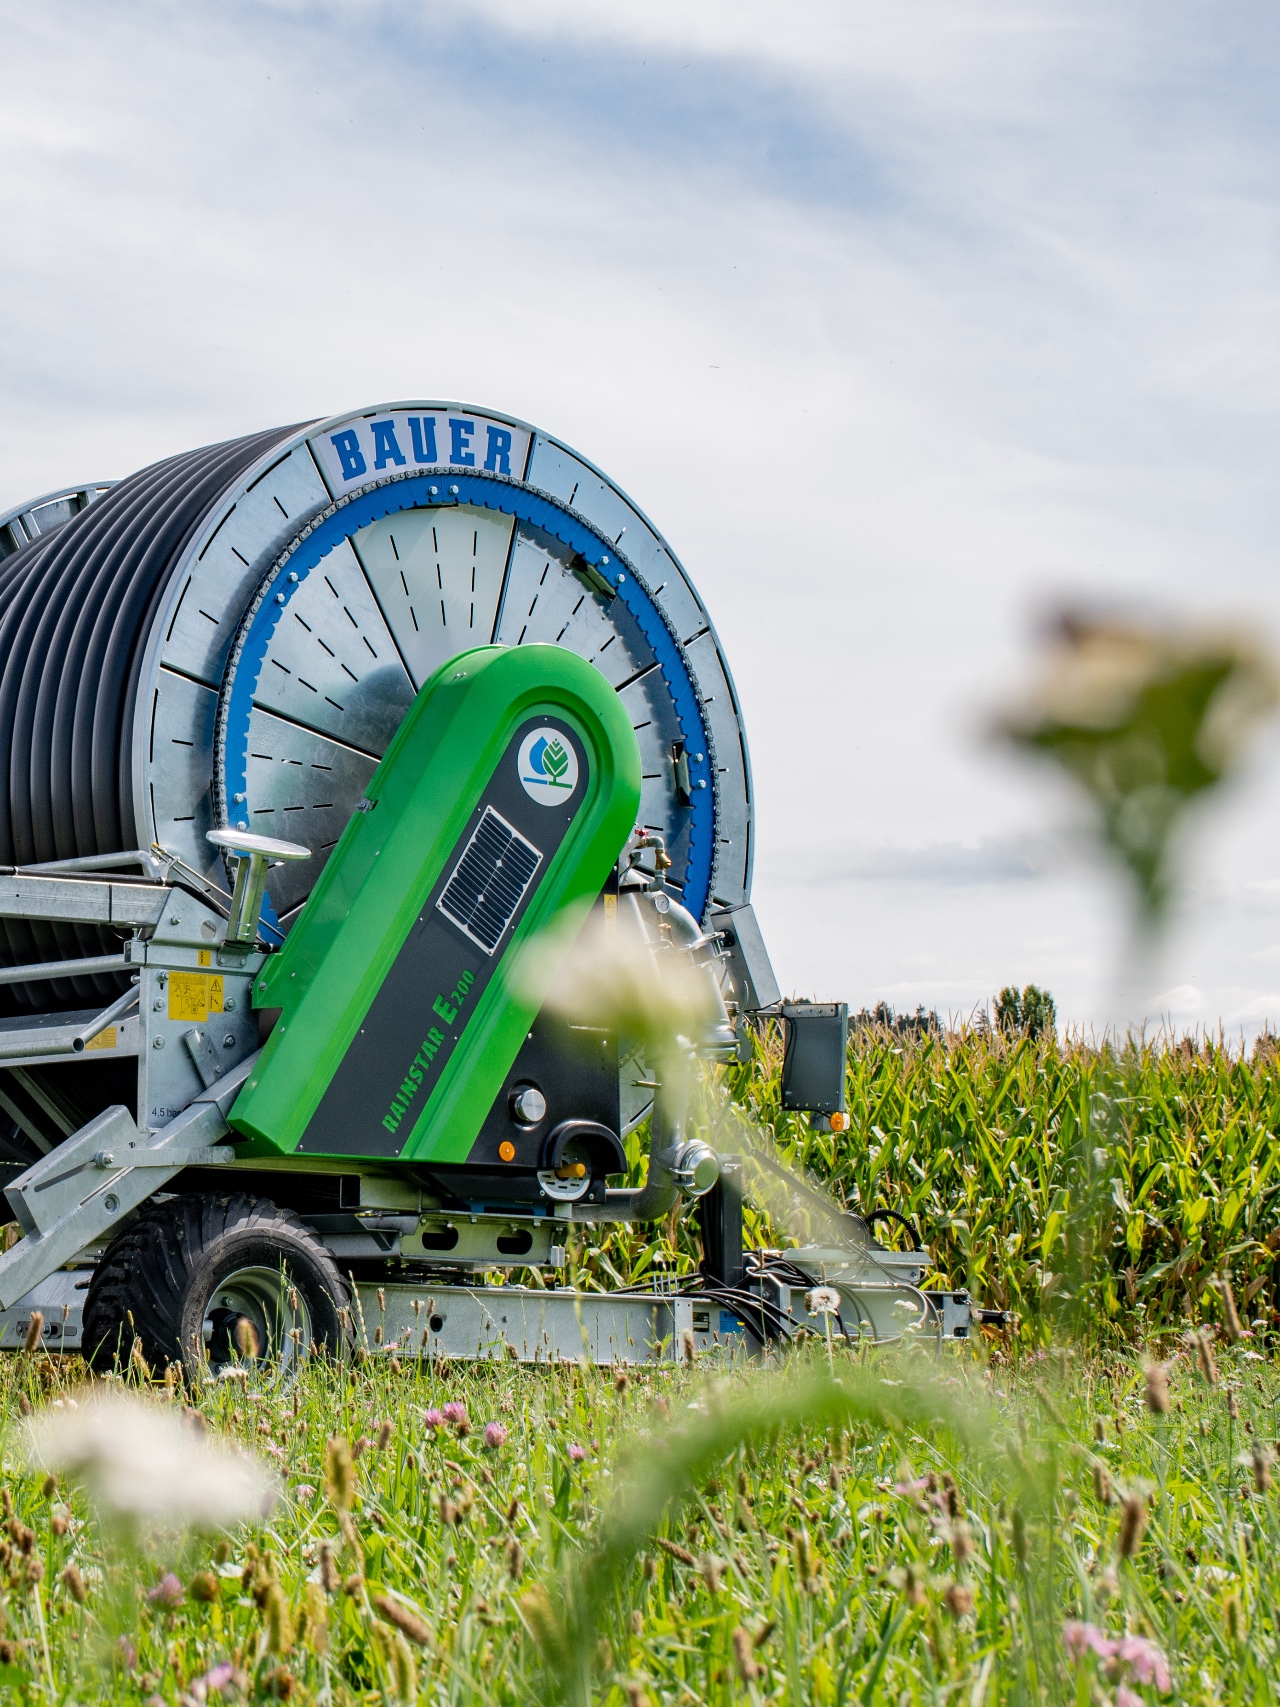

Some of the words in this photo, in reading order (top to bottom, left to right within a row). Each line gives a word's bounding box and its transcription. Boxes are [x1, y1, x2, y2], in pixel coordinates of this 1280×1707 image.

[330, 417, 511, 482] BAUER
[151, 1107, 165, 1118] 4,5
[382, 1026, 445, 1134] RAINSTAR
